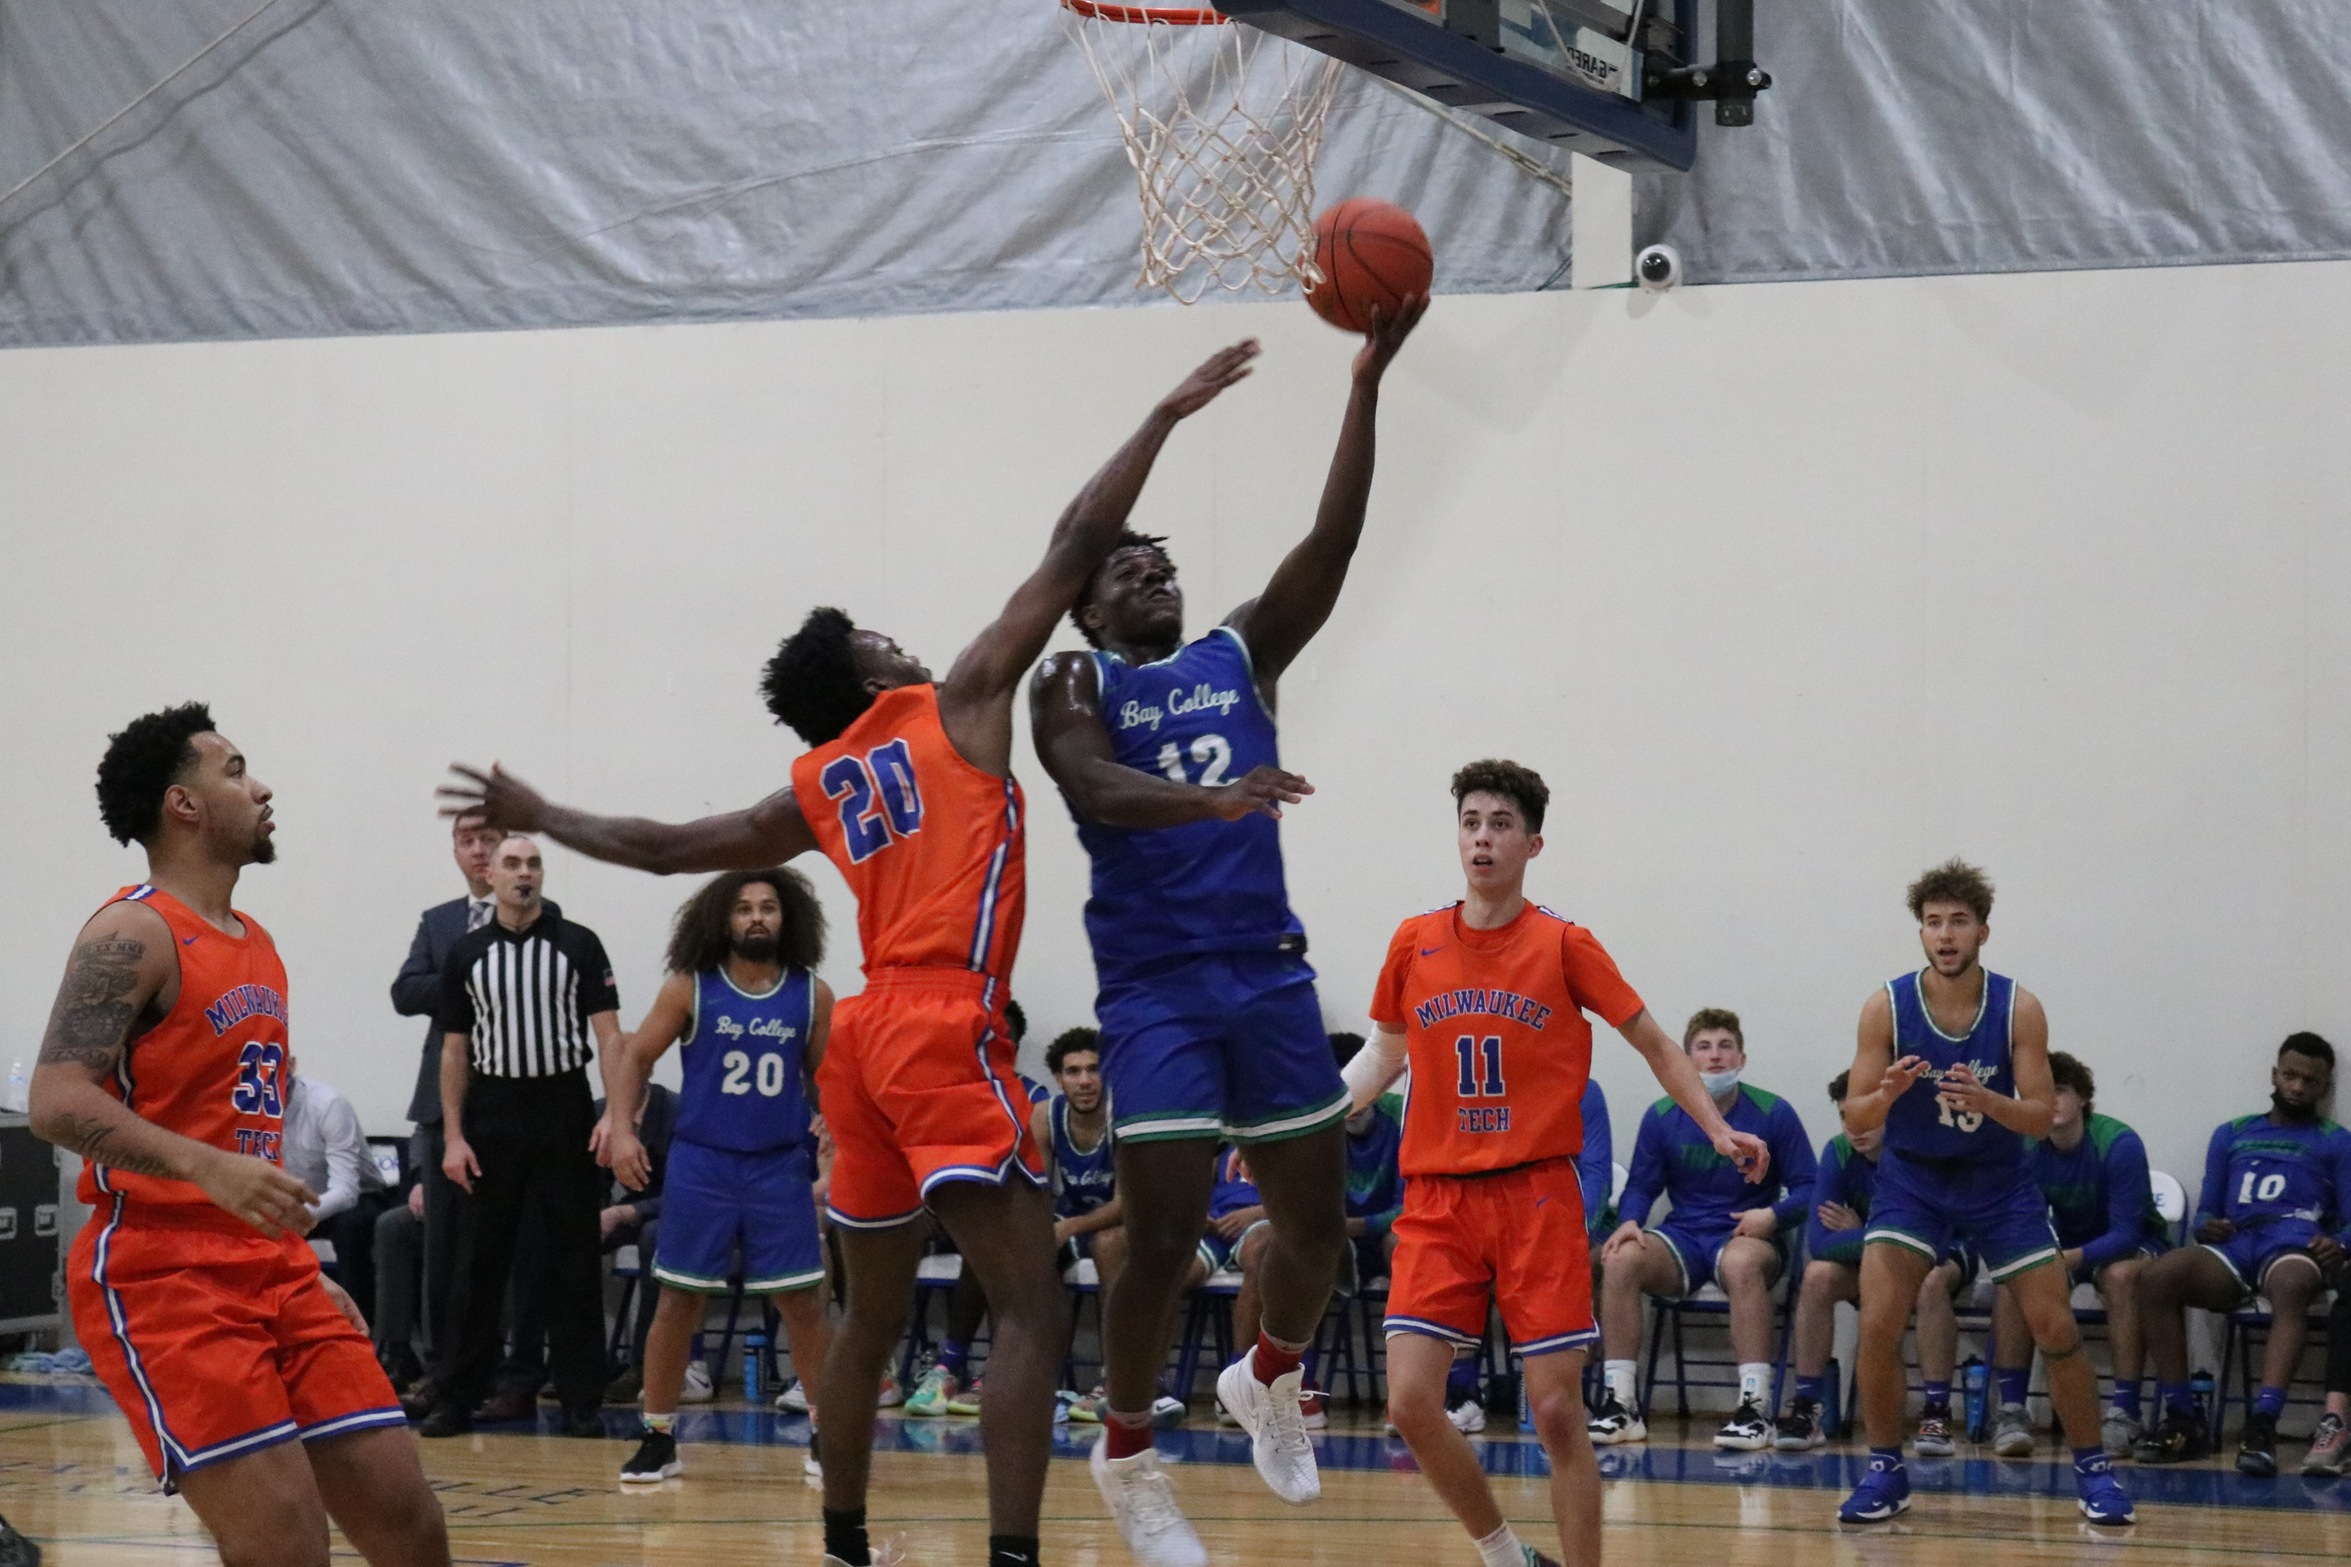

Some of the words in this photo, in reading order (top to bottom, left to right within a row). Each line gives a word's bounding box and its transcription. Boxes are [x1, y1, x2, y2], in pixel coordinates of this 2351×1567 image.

[1119, 700, 1164, 731] Bay
[1167, 682, 1240, 716] College
[1156, 733, 1242, 787] 12
[819, 737, 925, 865] 20
[715, 1015, 745, 1041] Bay
[748, 1017, 797, 1045] College
[1415, 988, 1552, 1031] MILWAUKEE
[232, 1041, 284, 1119] 33
[721, 1050, 784, 1097] 20
[1455, 1035, 1506, 1097] 11
[1458, 1106, 1511, 1133] TECH
[235, 1128, 281, 1162] TEC
[2237, 1171, 2286, 1204] 10
